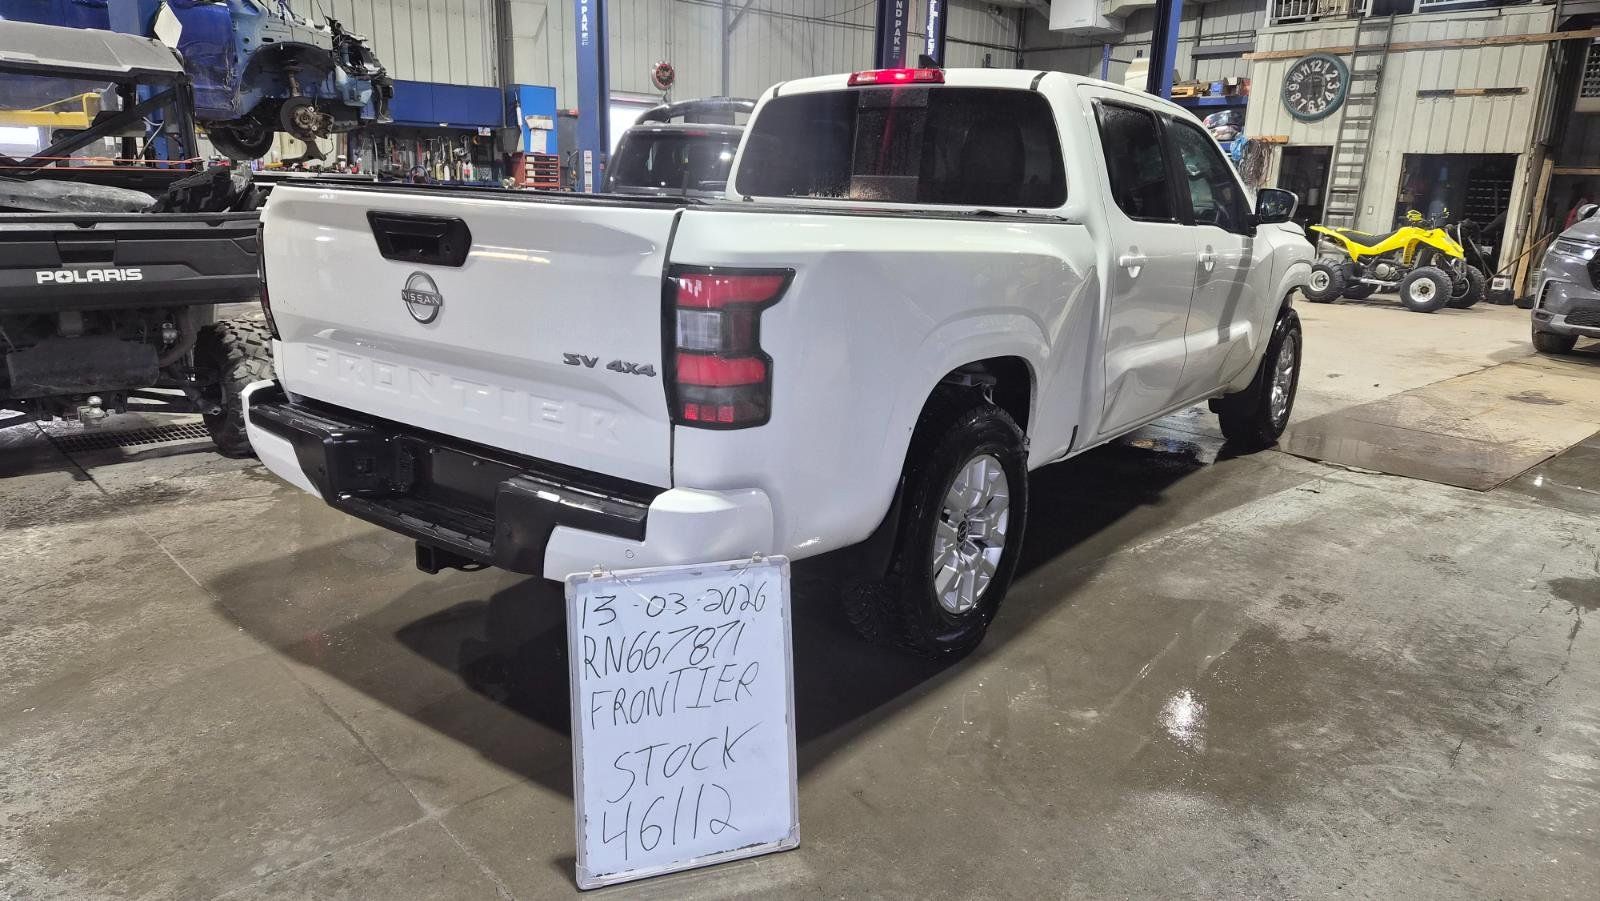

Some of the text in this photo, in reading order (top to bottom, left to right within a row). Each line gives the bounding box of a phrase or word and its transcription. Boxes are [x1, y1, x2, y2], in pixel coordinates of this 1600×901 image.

[893, 20, 902, 45] PAK
[1301, 63, 1311, 75] 11
[1310, 60, 1322, 72] 12
[1322, 62, 1330, 74] 1
[1292, 72, 1304, 82] 10
[1325, 70, 1338, 80] 2
[1288, 83, 1299, 91] 9
[1327, 81, 1340, 90] 3
[1291, 92, 1301, 102] 8
[1325, 91, 1335, 101] 4
[1297, 98, 1307, 110] 7
[1308, 100, 1317, 114] 6
[1317, 97, 1326, 111] 5
[36, 268, 143, 284] POLARIS
[402, 290, 440, 305] NISSAN
[563, 352, 599, 368] SV
[583, 619, 746, 680] RN667871
[590, 661, 760, 730] FRONTIER
[606, 721, 763, 803] STOCK
[602, 783, 741, 861] 46112
